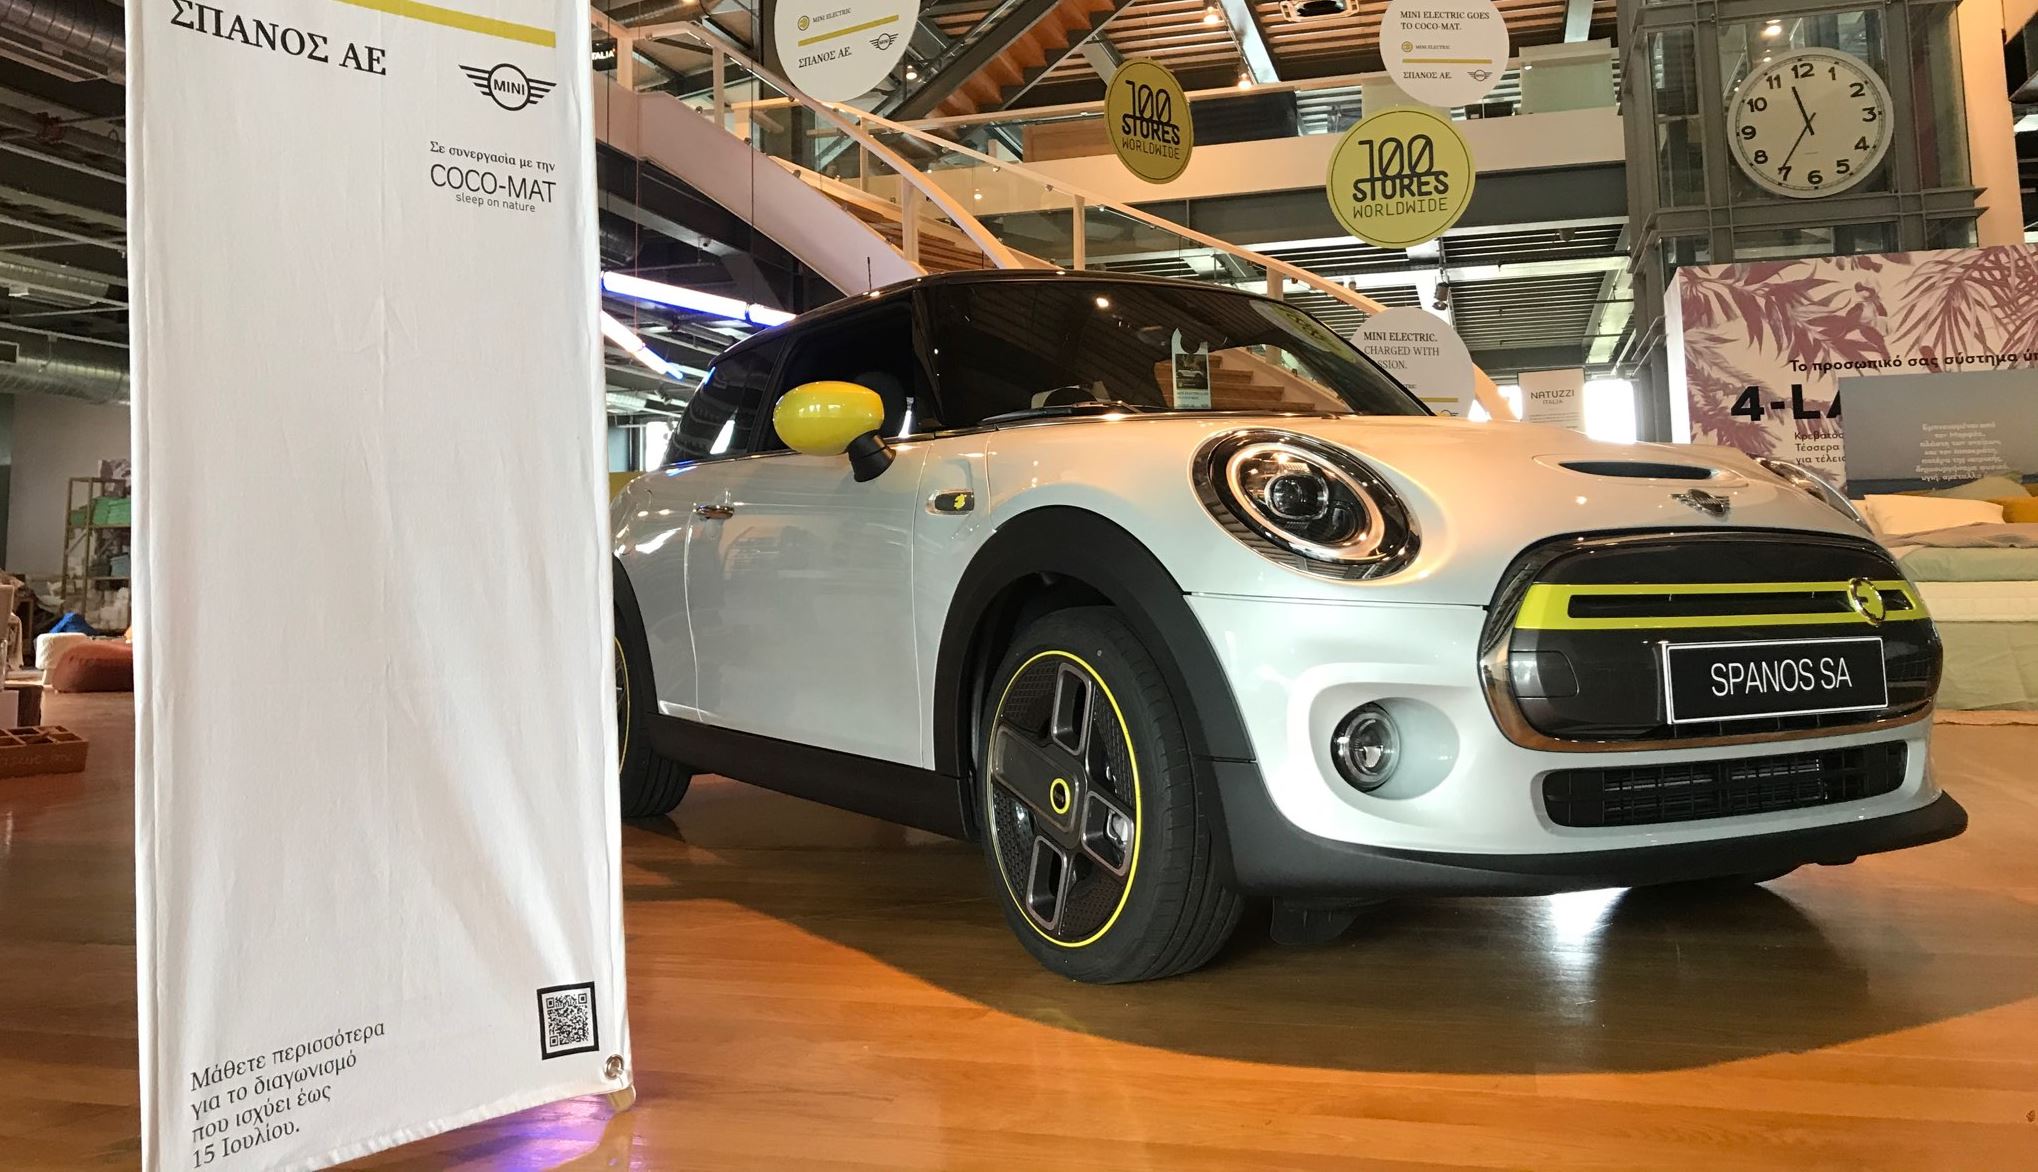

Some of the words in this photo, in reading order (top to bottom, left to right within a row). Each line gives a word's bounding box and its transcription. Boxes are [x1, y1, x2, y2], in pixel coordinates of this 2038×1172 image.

[1400, 11, 1421, 19] MINI
[1423, 11, 1465, 19] ELECTRIC
[1467, 12, 1490, 20] GOES
[1400, 22, 1413, 30] TO
[171, 0, 329, 63] ΣΠΑΝΟΣ
[339, 42, 387, 76] ΑΕ
[798, 50, 836, 69] ΣΠΑΝΟΣ
[1403, 71, 1438, 79] ΣΠΑΝΟΣ
[1790, 62, 1815, 79] 12
[1828, 66, 1837, 81] 1
[493, 78, 525, 96] MINI
[1766, 74, 1782, 89] 11
[1849, 82, 1866, 98] 2
[1124, 79, 1172, 123] 100
[1747, 96, 1768, 113] 10
[1862, 106, 1877, 122] 3
[1121, 113, 1181, 146] STORES
[1741, 125, 1757, 140] 9
[1121, 137, 1181, 160] WORLDWIDE
[1854, 136, 1870, 151] 4
[430, 140, 446, 154] Σε
[448, 147, 517, 166] συνεργασία
[519, 158, 533, 169] με
[536, 161, 556, 173] την
[1358, 133, 1434, 178] 100
[1753, 149, 1769, 164] 8
[1778, 166, 1792, 181] 7
[1836, 158, 1850, 174] 5
[430, 163, 557, 203] COCO-MAT
[1807, 170, 1823, 185] 6
[1352, 170, 1449, 203] STORES
[456, 192, 484, 207] sleep
[487, 198, 500, 207] on
[502, 201, 536, 213] nature
[1353, 197, 1448, 219] WORLDWIDE
[1363, 331, 1387, 341] MINI
[1389, 331, 1438, 342] ELECTRIC.
[1364, 345, 1411, 355] CHARGED
[1413, 346, 1440, 356] WITH
[1377, 359, 1408, 370] SSION.
[1788, 359, 1808, 373] Το
[1812, 355, 1903, 374] προσωπικό
[1907, 356, 1938, 368] σας
[1944, 351, 2018, 367] σύστημα
[1530, 389, 1575, 399] NATUZZI
[1795, 443, 1840, 453] Τέσσερα
[1795, 456, 1812, 466] για
[1710, 658, 1815, 697] SPANOS
[1820, 657, 1853, 690] SA
[190, 1055, 266, 1092] Μάθετε
[272, 1022, 385, 1065] περισσότερα
[191, 1095, 221, 1120] για
[227, 1086, 248, 1105] το
[254, 1050, 357, 1095] διαγωνισμό
[192, 1118, 229, 1143] που
[236, 1097, 291, 1126] ισχύει
[297, 1085, 332, 1107] έως
[193, 1144, 216, 1169] 15
[221, 1119, 300, 1158] Ιουλίου.
